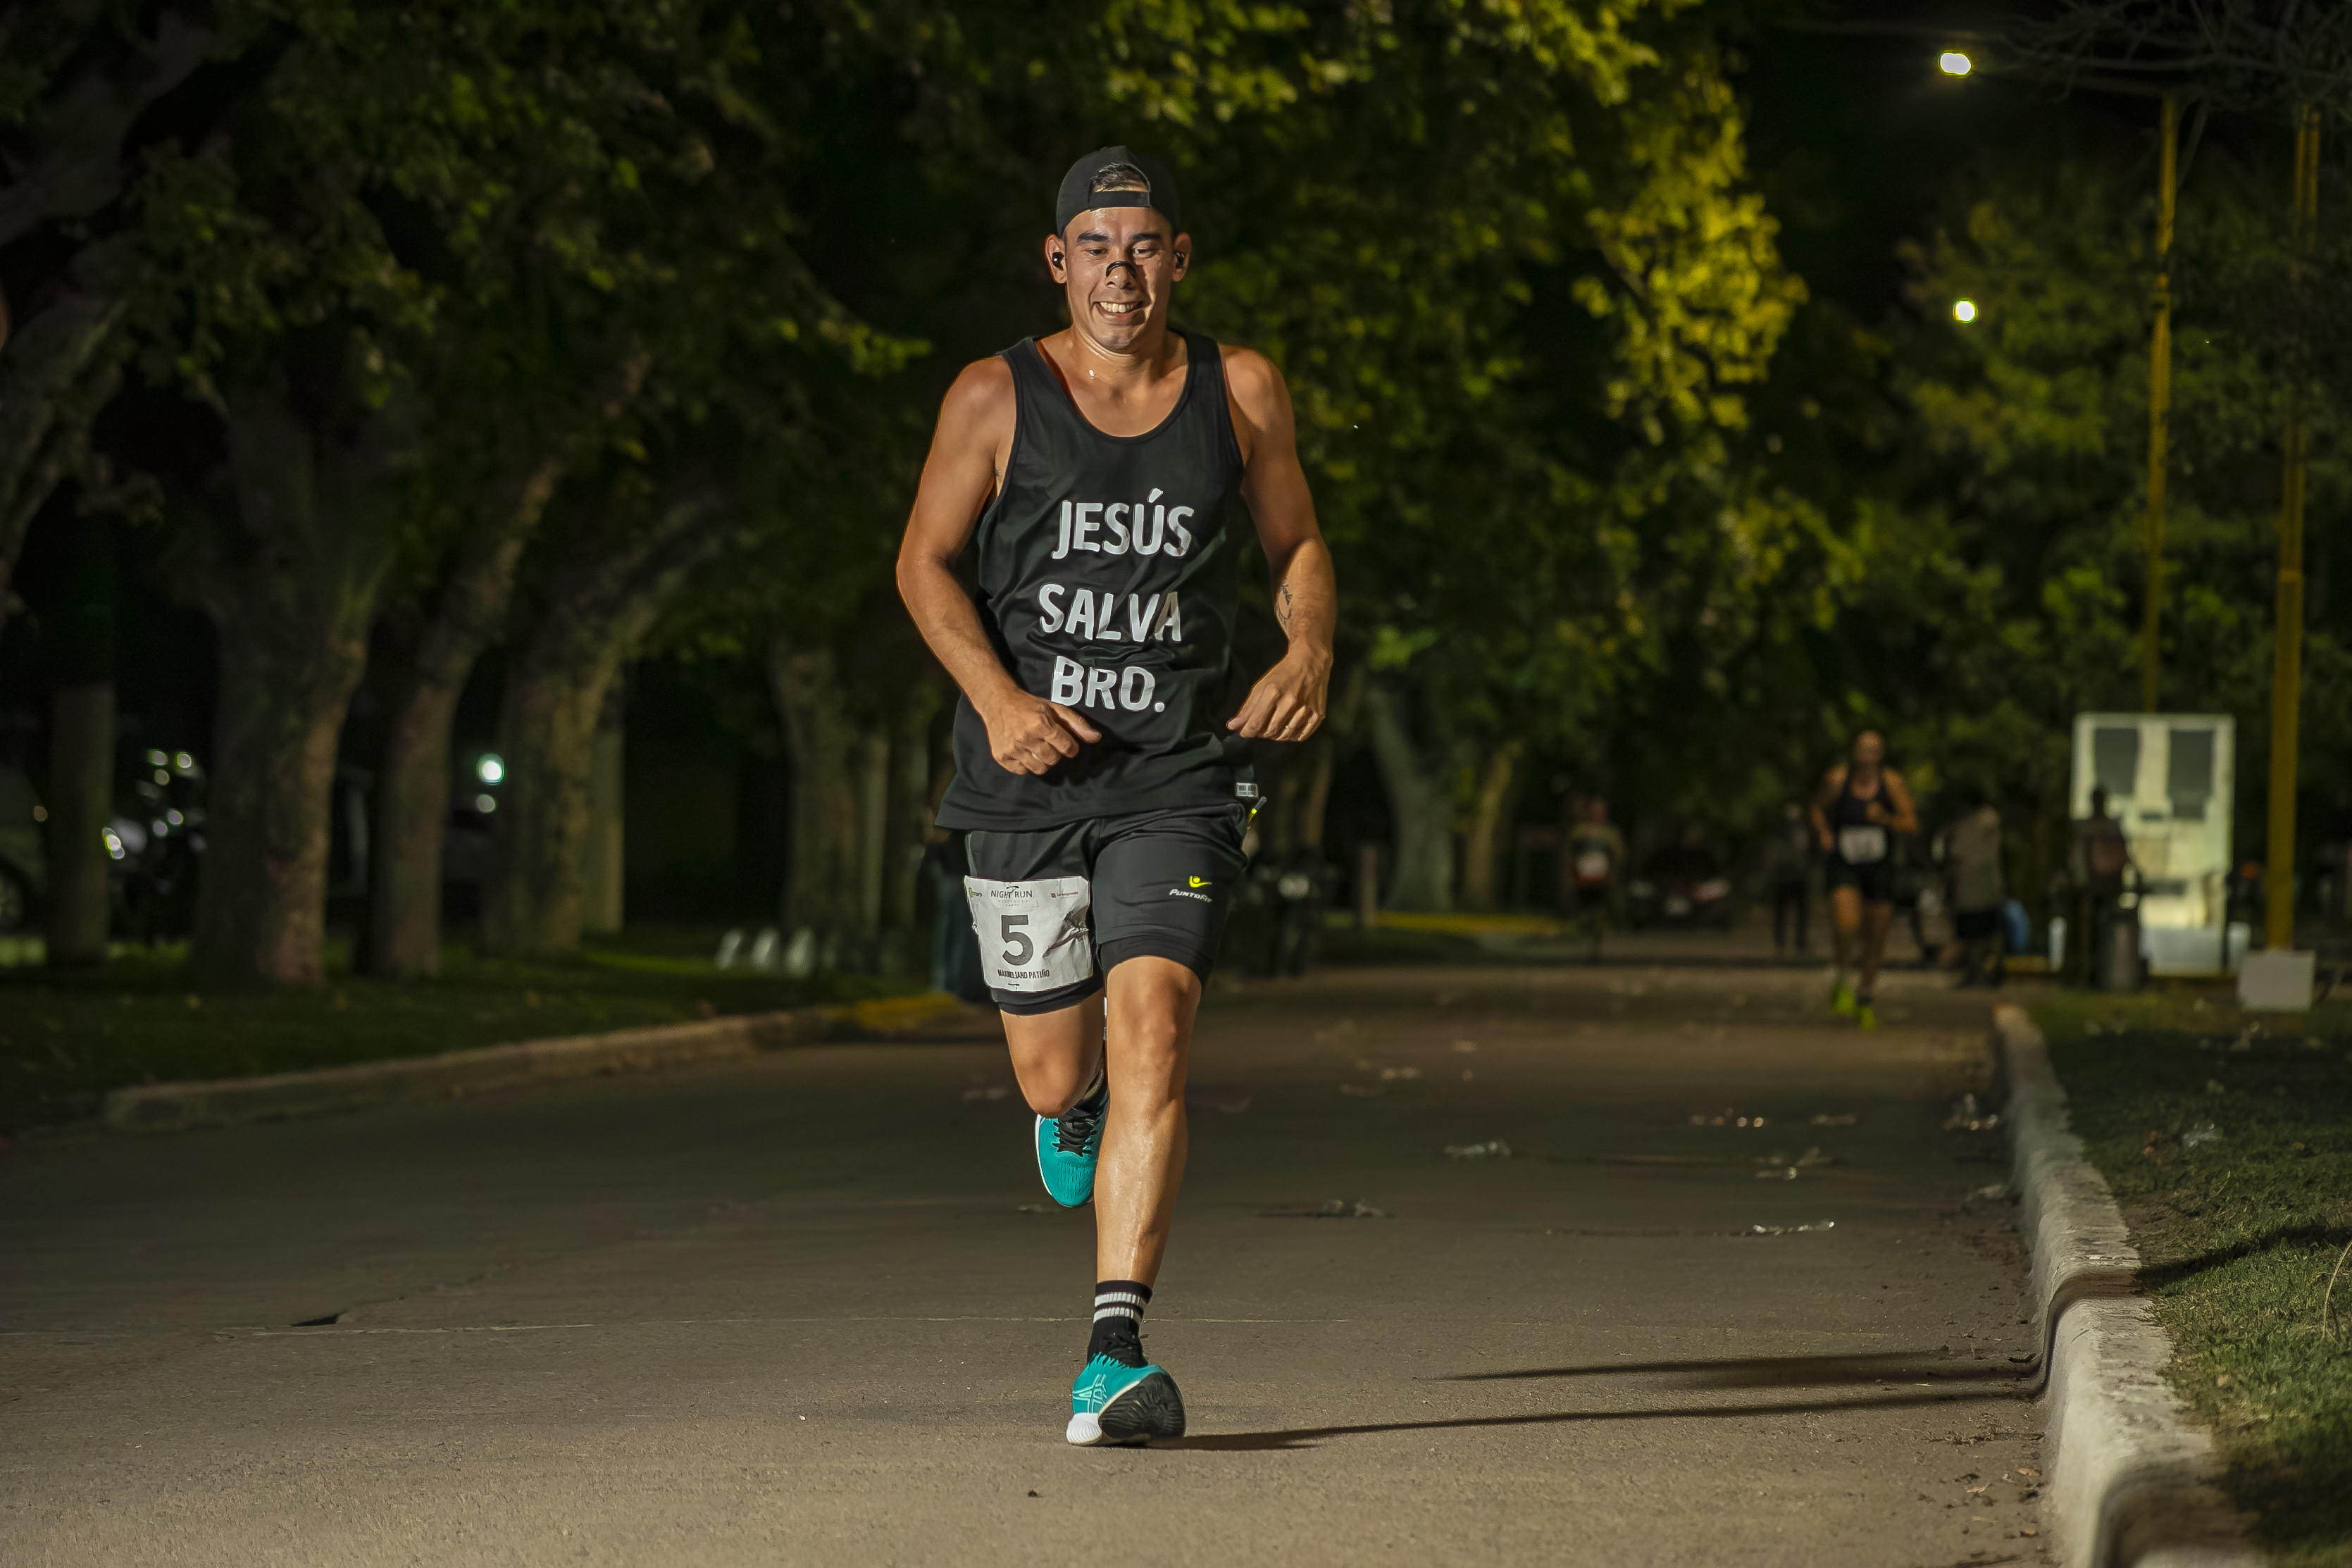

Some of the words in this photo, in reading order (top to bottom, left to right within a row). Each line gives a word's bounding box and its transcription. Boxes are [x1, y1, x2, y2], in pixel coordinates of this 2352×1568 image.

[1052, 487, 1194, 559] JESÚS
[1038, 583, 1181, 642] SALVA
[1051, 655, 1165, 712] BRO.
[990, 890, 1012, 898] NIGHT
[1014, 890, 1033, 898] RUN
[1001, 914, 1033, 966] 5
